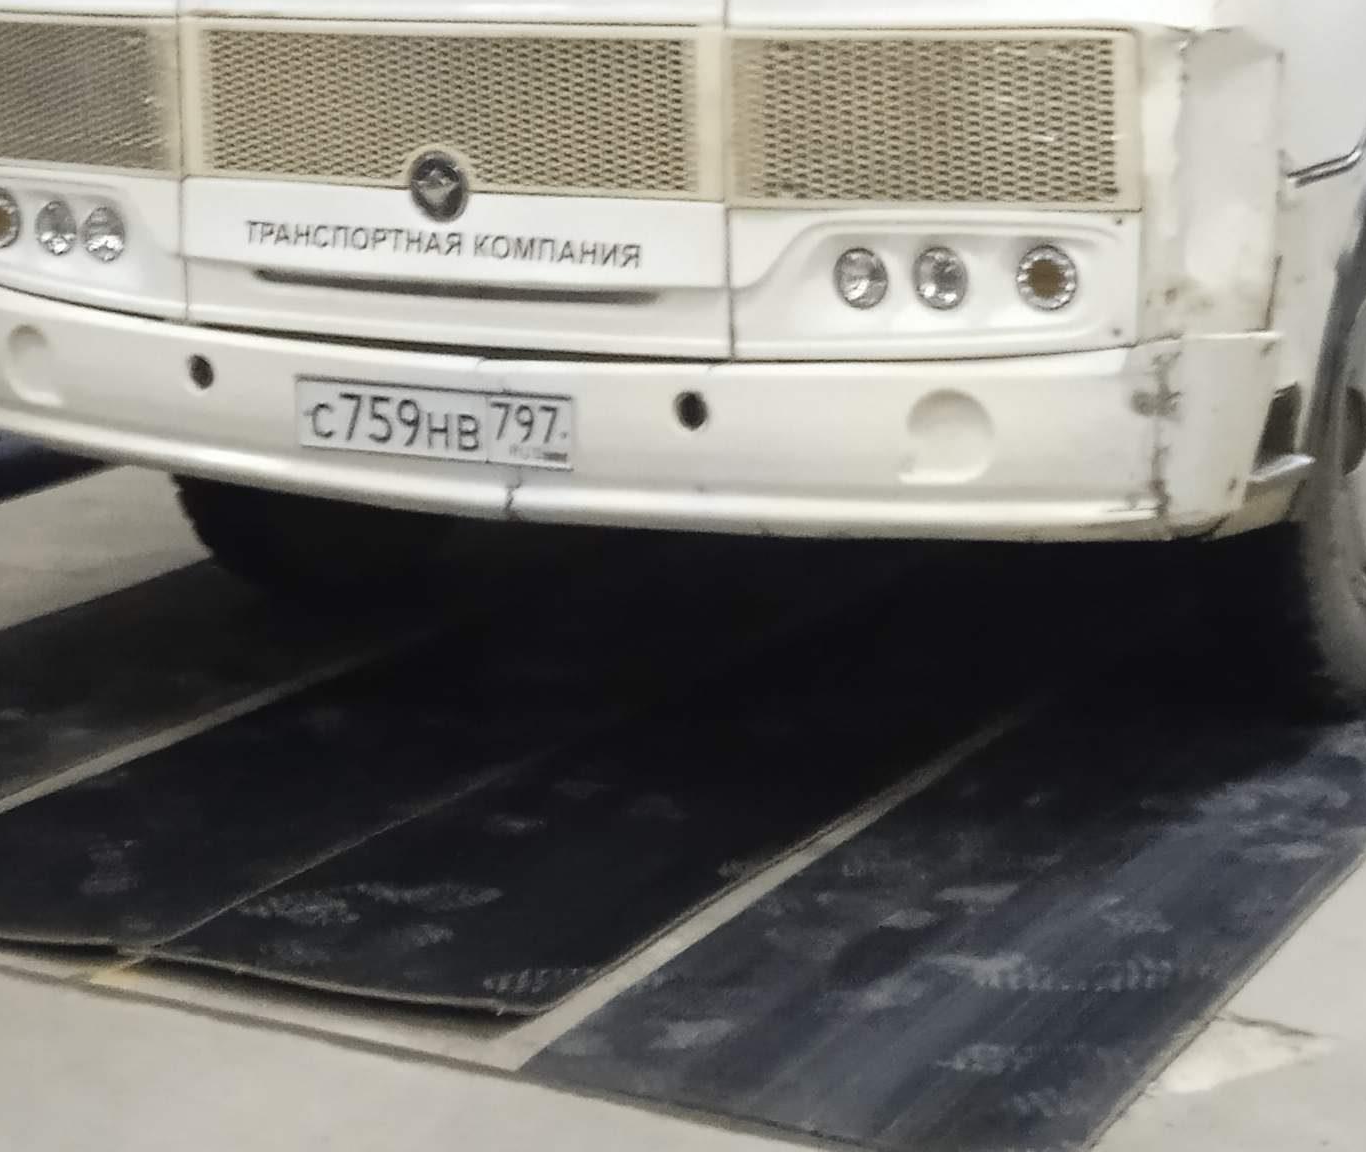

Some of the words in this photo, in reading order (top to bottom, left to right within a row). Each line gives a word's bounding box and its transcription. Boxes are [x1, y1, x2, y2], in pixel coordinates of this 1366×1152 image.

[246, 220, 463, 256] ТРАНСПОРТНАЯ
[473, 232, 642, 268] КОМПАНИЯ
[490, 401, 559, 444] 797
